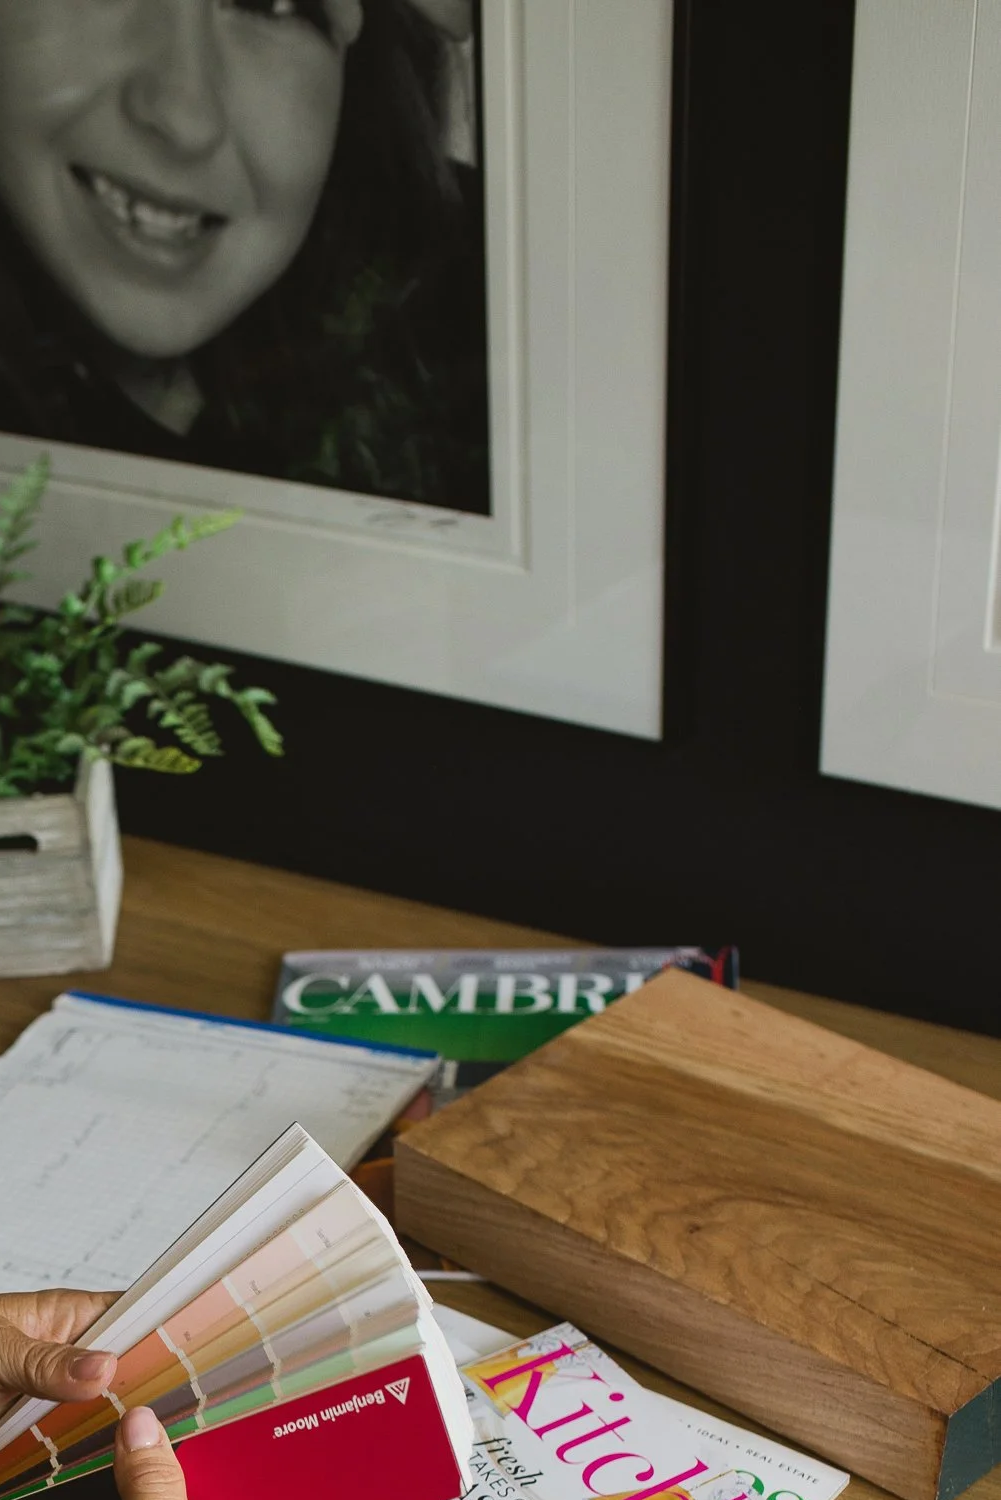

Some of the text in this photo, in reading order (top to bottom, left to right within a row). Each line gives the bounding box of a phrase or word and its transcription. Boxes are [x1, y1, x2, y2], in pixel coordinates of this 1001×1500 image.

[273, 1389, 386, 1438] Benjamin Moore
[468, 1451, 516, 1498] TAKES
[473, 1437, 544, 1488] fresh
[744, 1448, 773, 1464] REAL
[778, 1462, 820, 1485] ESTATE
